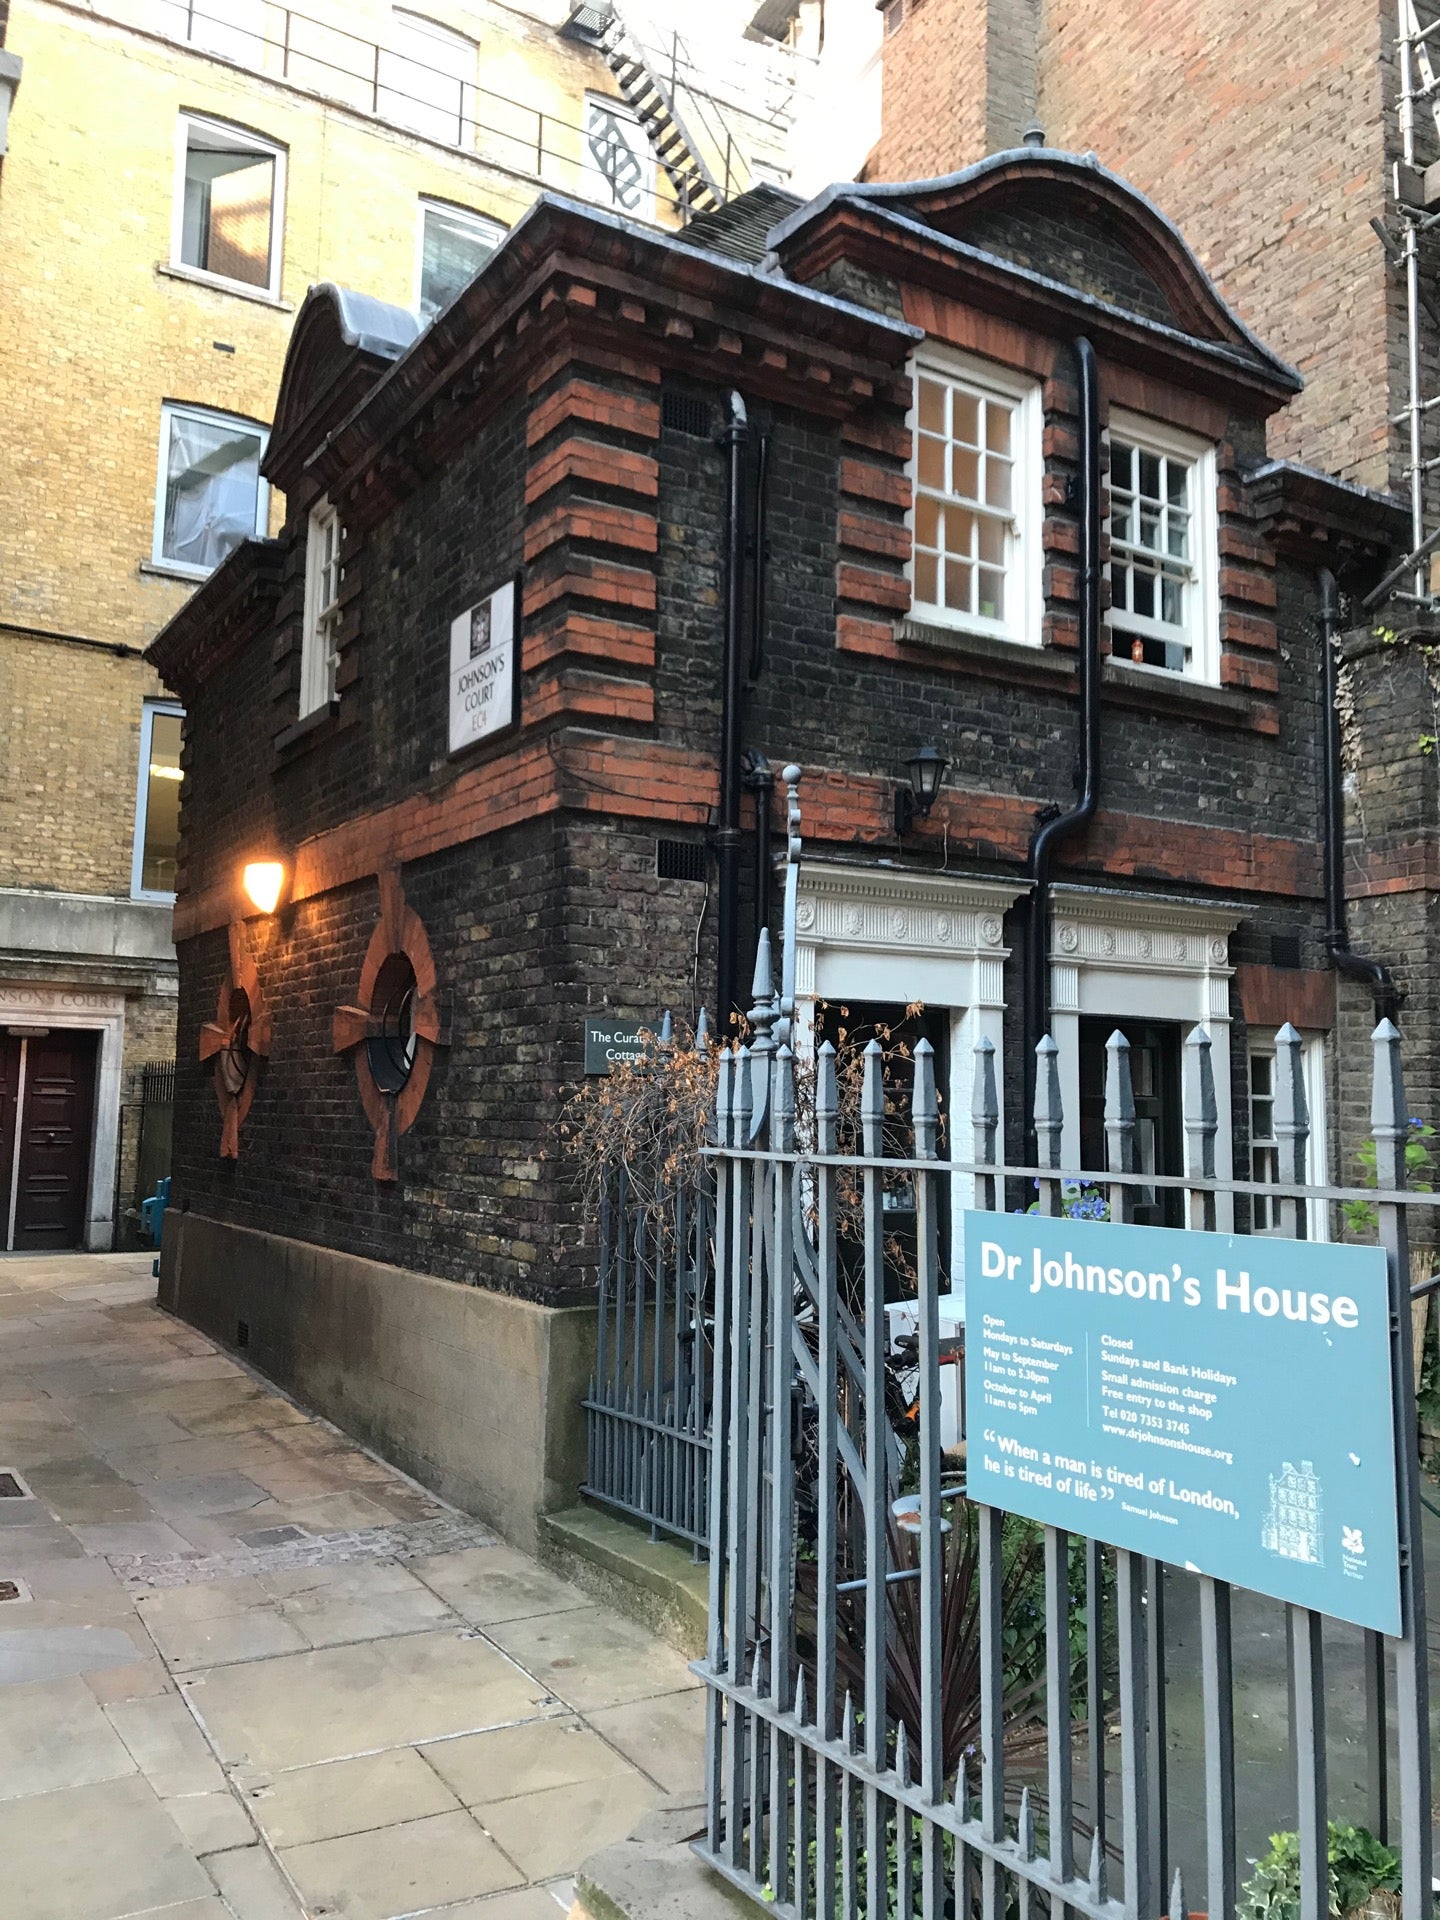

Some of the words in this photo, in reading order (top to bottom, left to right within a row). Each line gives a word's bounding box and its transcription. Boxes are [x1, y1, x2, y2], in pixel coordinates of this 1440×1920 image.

[457, 653, 505, 696] JOHNSON'S
[465, 682, 494, 712] COURT
[472, 710, 487, 732] EC4
[61, 993, 120, 1009] COURT
[590, 1030, 612, 1043] The
[614, 1031, 664, 1044] Curat's
[981, 1241, 1022, 1281] Dr
[1029, 1247, 1201, 1307] Johnson's
[1216, 1268, 1360, 1329] House
[983, 1314, 1005, 1328] Open
[983, 1328, 1018, 1346] Mondays
[1019, 1336, 1029, 1346] to
[1030, 1337, 1074, 1356] Saturdays
[1101, 1334, 1134, 1350] Closed
[983, 1346, 1000, 1361] May
[1001, 1351, 1011, 1361] to
[1012, 1352, 1060, 1371] September
[1101, 1350, 1140, 1368] Sundays
[1142, 1359, 1160, 1371] and
[1162, 1361, 1189, 1377] Bank
[1191, 1366, 1237, 1387] Holidays
[984, 1361, 1006, 1375] 11am
[1007, 1367, 1017, 1377] to
[1018, 1368, 1050, 1385] 5.30pm
[983, 1379, 1018, 1395] October
[1019, 1389, 1029, 1399] to
[1030, 1390, 1053, 1404] April
[1101, 1370, 1128, 1385] Small
[1130, 1377, 1180, 1395] admission
[1181, 1386, 1218, 1405] charge
[985, 1393, 1007, 1409] 11am
[1007, 1400, 1018, 1411] to
[1018, 1401, 1039, 1416] 5pm
[1101, 1385, 1124, 1400] Free
[1126, 1392, 1152, 1408] entry
[1154, 1397, 1166, 1409] to
[1167, 1399, 1186, 1413] the
[1187, 1403, 1213, 1421] shop
[1102, 1405, 1118, 1419] Tel
[1120, 1409, 1138, 1423] 020
[1140, 1413, 1163, 1429] 7353
[1165, 1418, 1191, 1435] 3745
[1102, 1423, 1234, 1465] www.drjohnsonshouse.org
[984, 1453, 1001, 1474] he
[1004, 1461, 1015, 1478] is
[1018, 1465, 1052, 1489] tired
[1056, 1477, 1072, 1495] of
[1042, 1450, 1052, 1466] a
[1054, 1453, 1087, 1476] man
[1090, 1460, 1103, 1480] is
[1106, 1464, 1144, 1491] tired
[1148, 1475, 1167, 1497] of
[1169, 1480, 1240, 1520] London,
[1121, 1501, 1148, 1517] Samuel
[1149, 1509, 1179, 1526] Johnson
